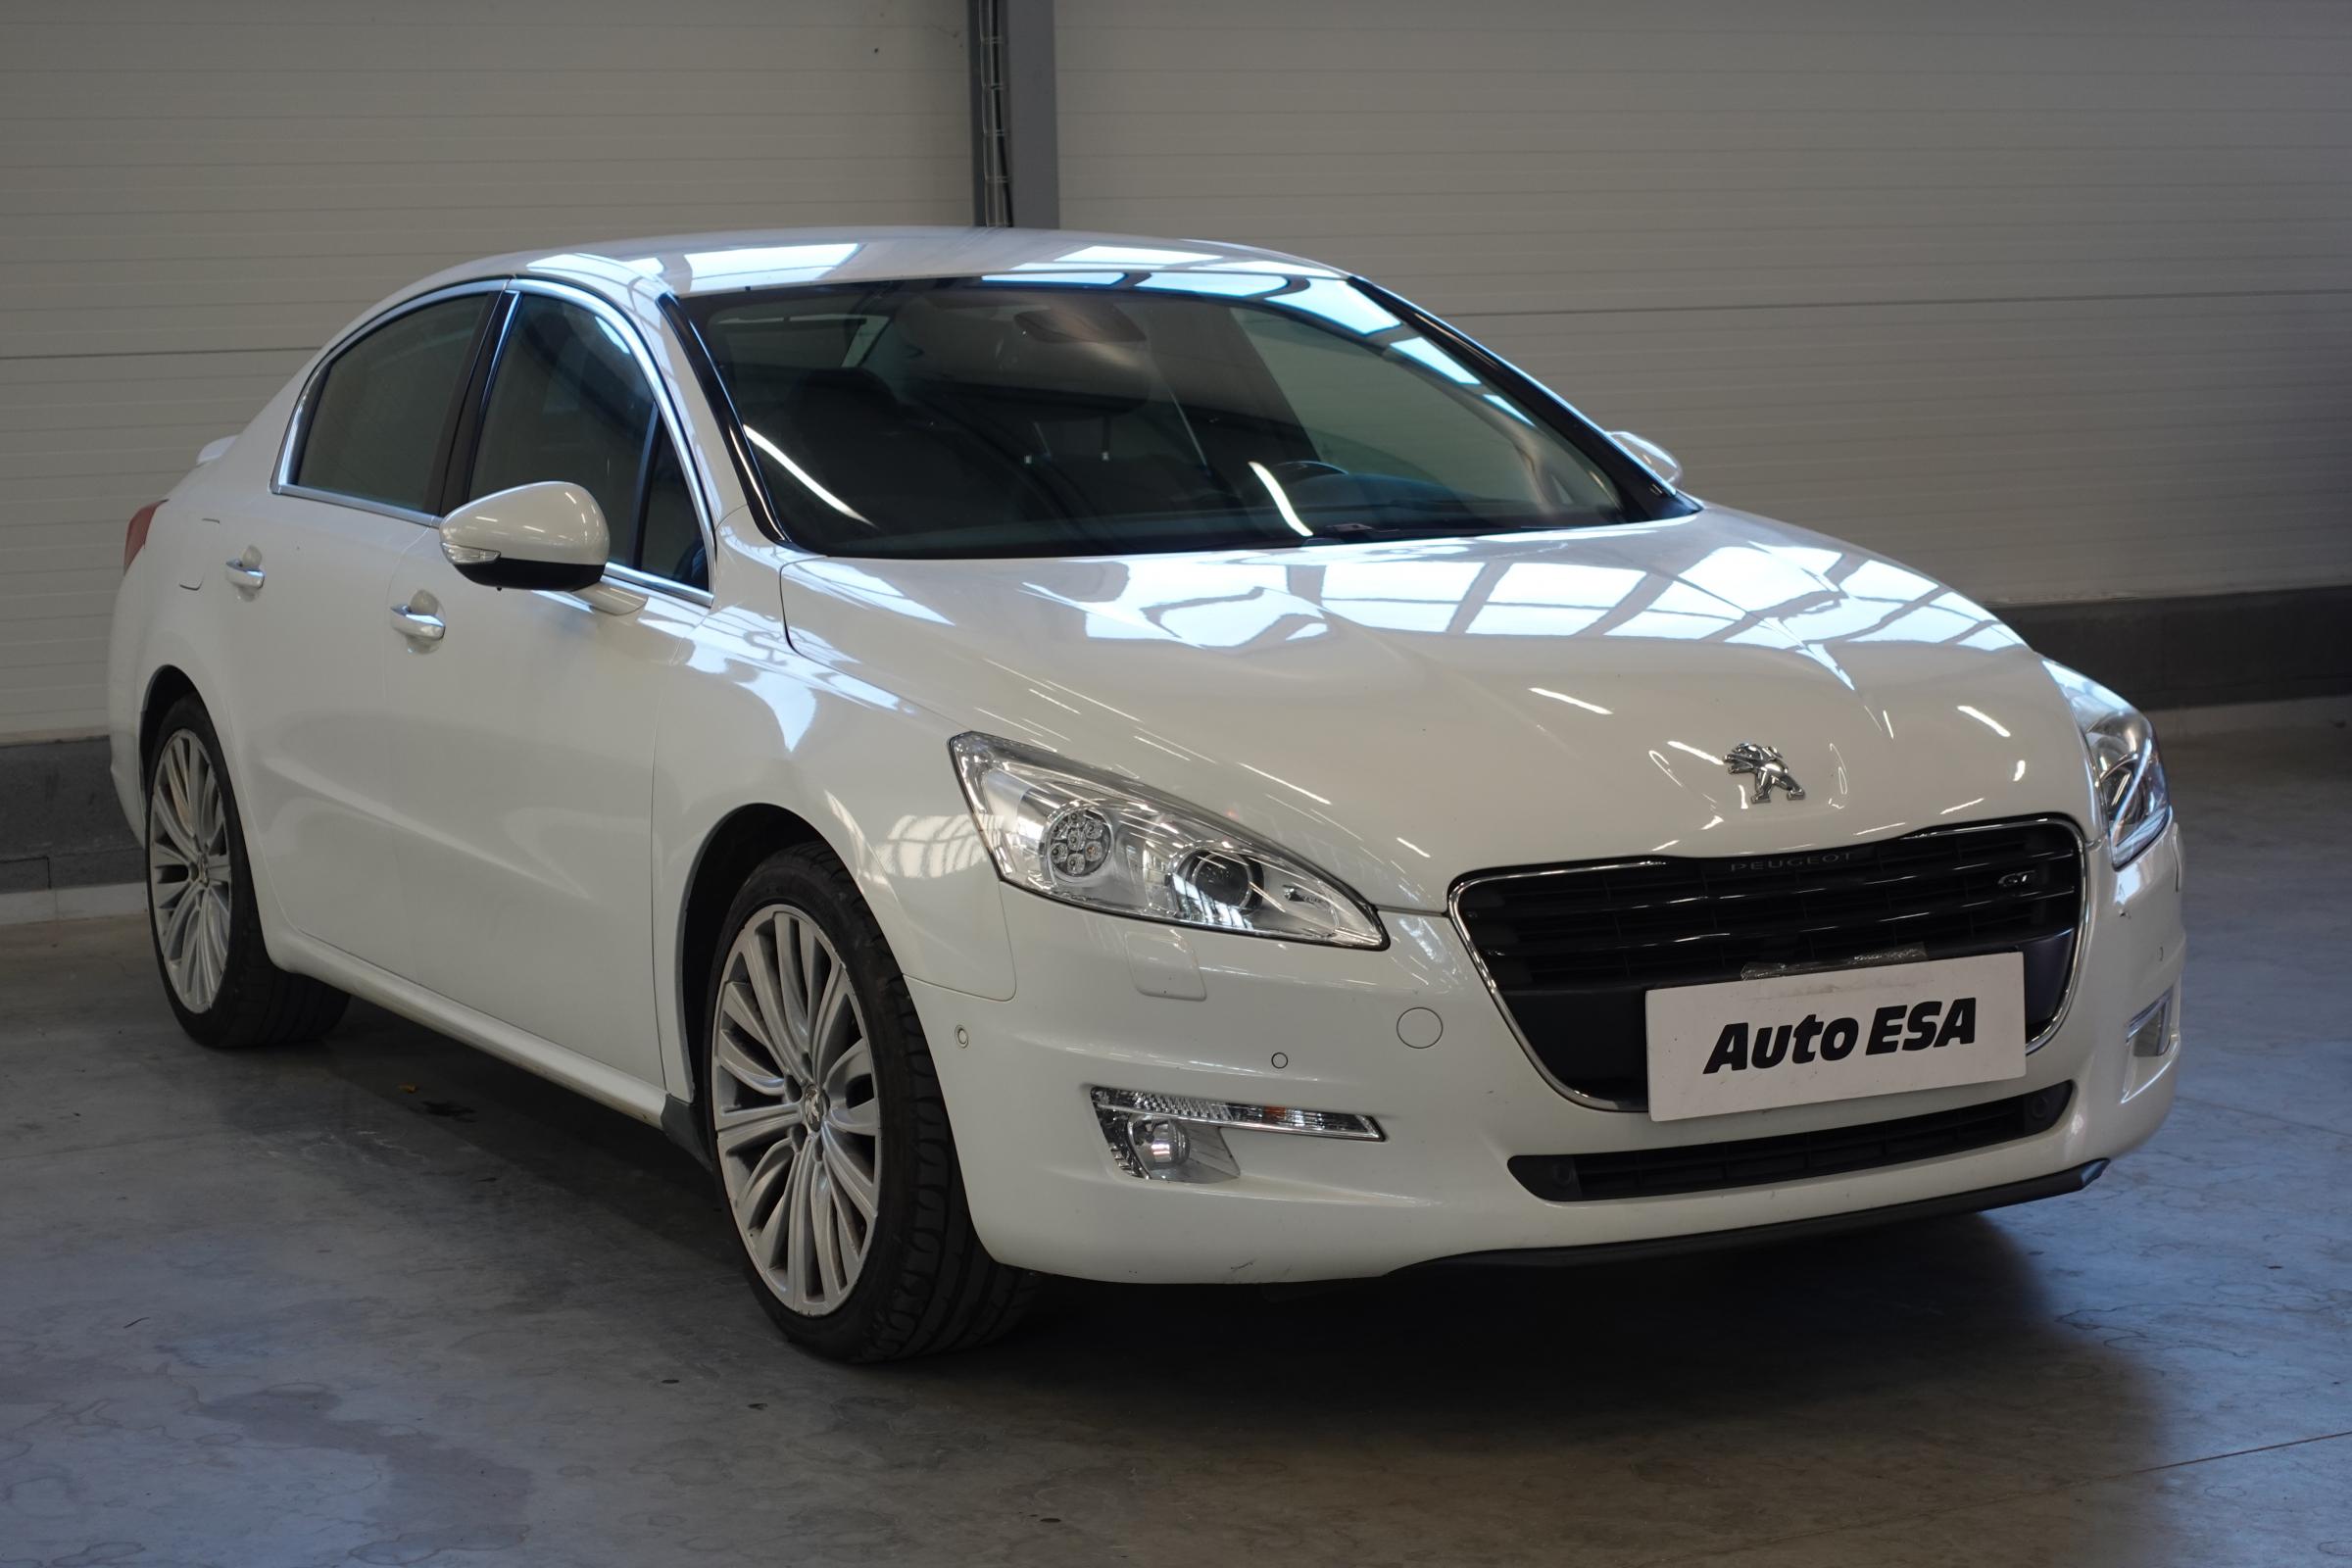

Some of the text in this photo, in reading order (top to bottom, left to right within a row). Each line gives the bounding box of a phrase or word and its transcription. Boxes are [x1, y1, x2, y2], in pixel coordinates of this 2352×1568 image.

[1731, 853, 1853, 871] PEUGEOT
[1702, 997, 1977, 1074] Auto ESA
